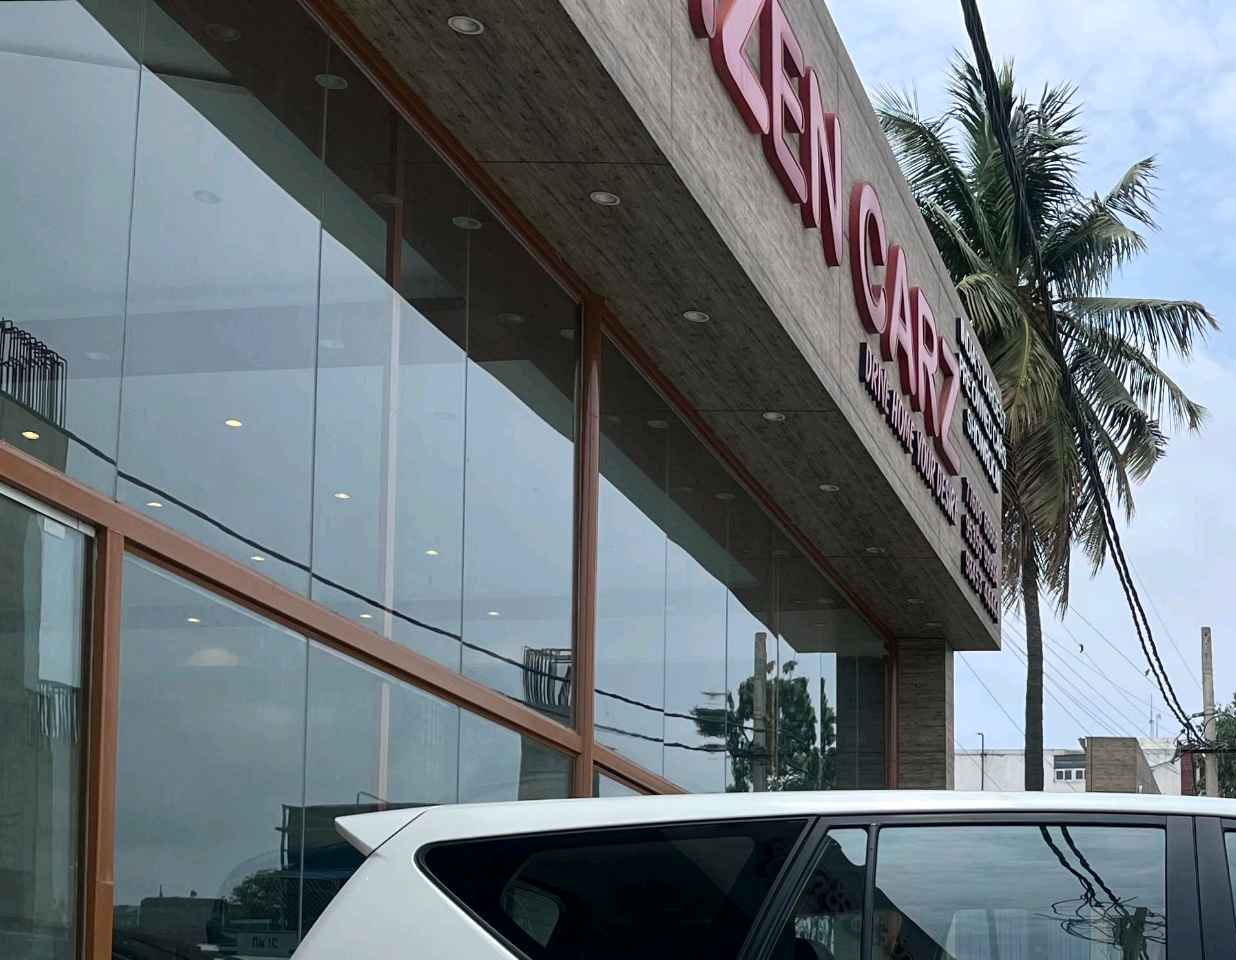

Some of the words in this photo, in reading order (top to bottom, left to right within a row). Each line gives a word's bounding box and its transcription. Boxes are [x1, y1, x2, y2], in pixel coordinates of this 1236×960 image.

[690, 0, 844, 267] ZEN
[851, 182, 961, 475] CARZ
[862, 343, 891, 415] DRIVE
[890, 391, 915, 454] HOME
[914, 431, 937, 488] YOUR
